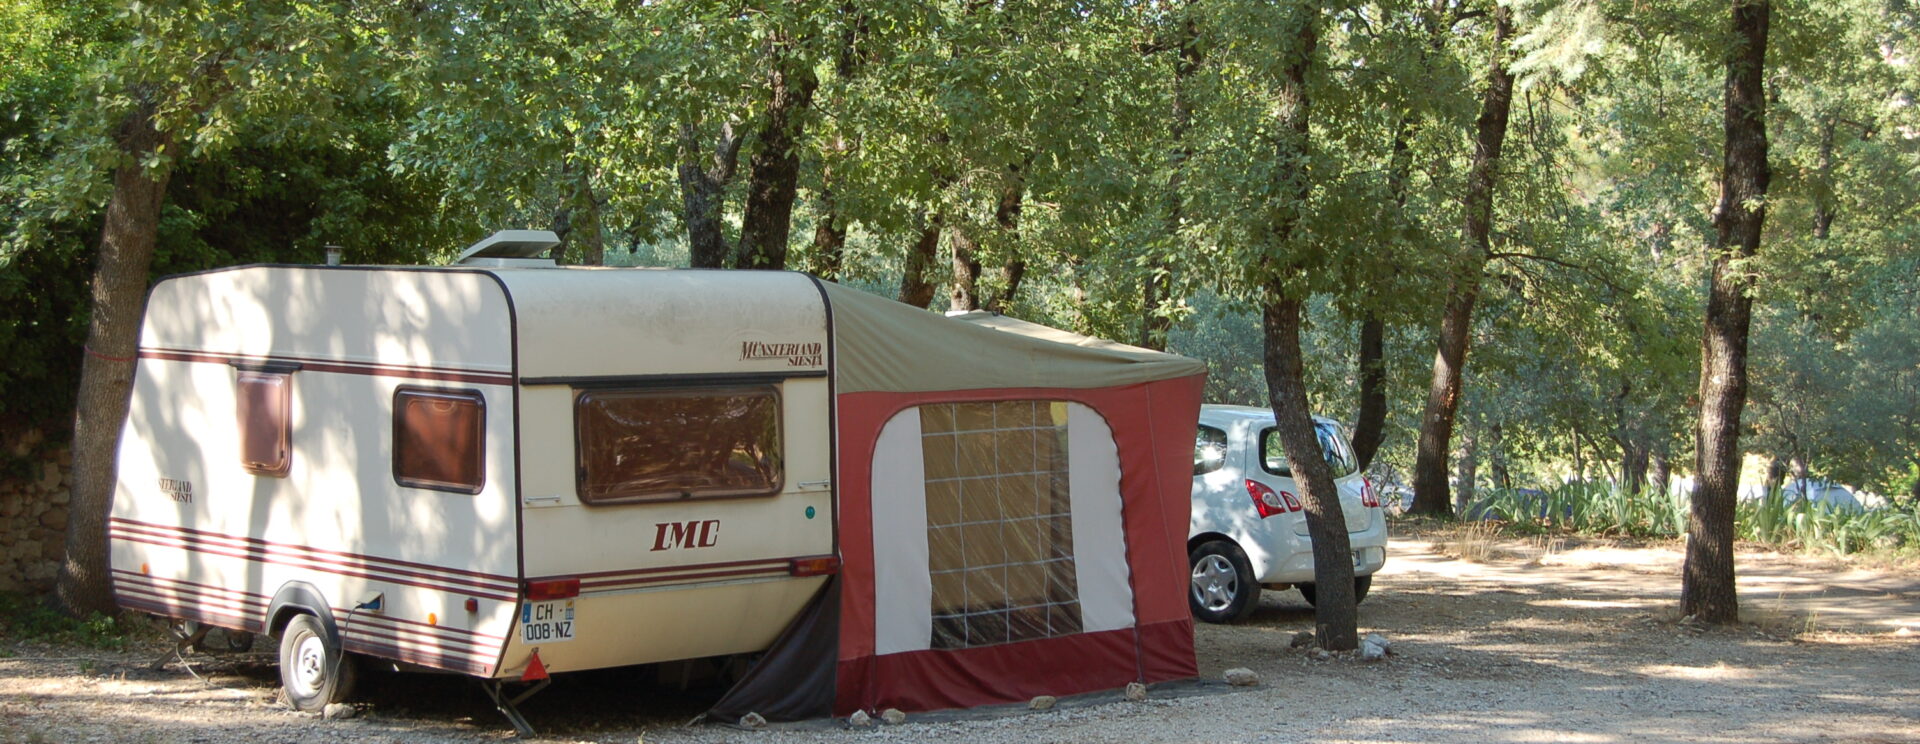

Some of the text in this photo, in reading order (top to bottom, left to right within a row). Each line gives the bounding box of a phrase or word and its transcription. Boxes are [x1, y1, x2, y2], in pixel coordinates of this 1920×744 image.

[787, 354, 822, 368] SIESTA
[650, 519, 720, 552] IMC
[536, 602, 554, 621] CH
